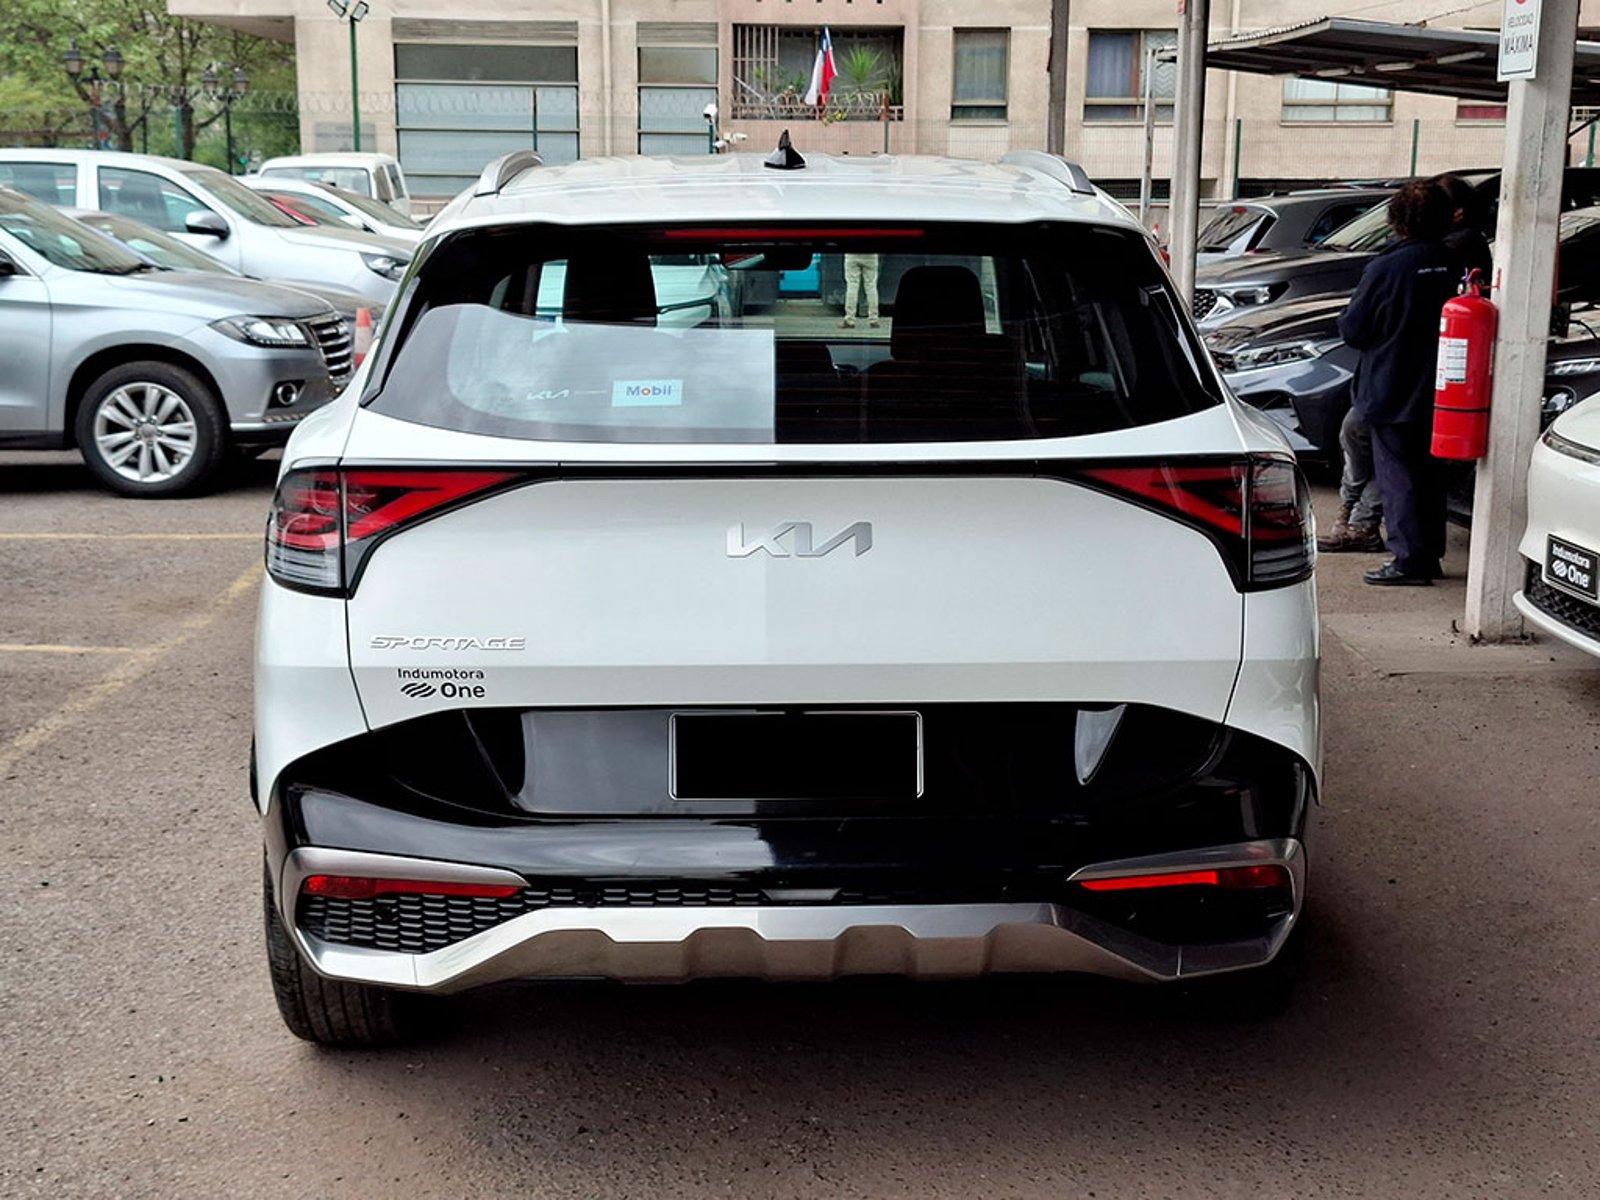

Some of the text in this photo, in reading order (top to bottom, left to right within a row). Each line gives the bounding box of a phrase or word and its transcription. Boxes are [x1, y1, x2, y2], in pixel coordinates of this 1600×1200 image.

[626, 385, 672, 396] Mobil
[726, 521, 873, 558] KIA
[1567, 564, 1590, 588] One
[370, 635, 526, 651] SPORTAGE
[397, 668, 485, 680] Indumotora
[440, 682, 486, 698] One
